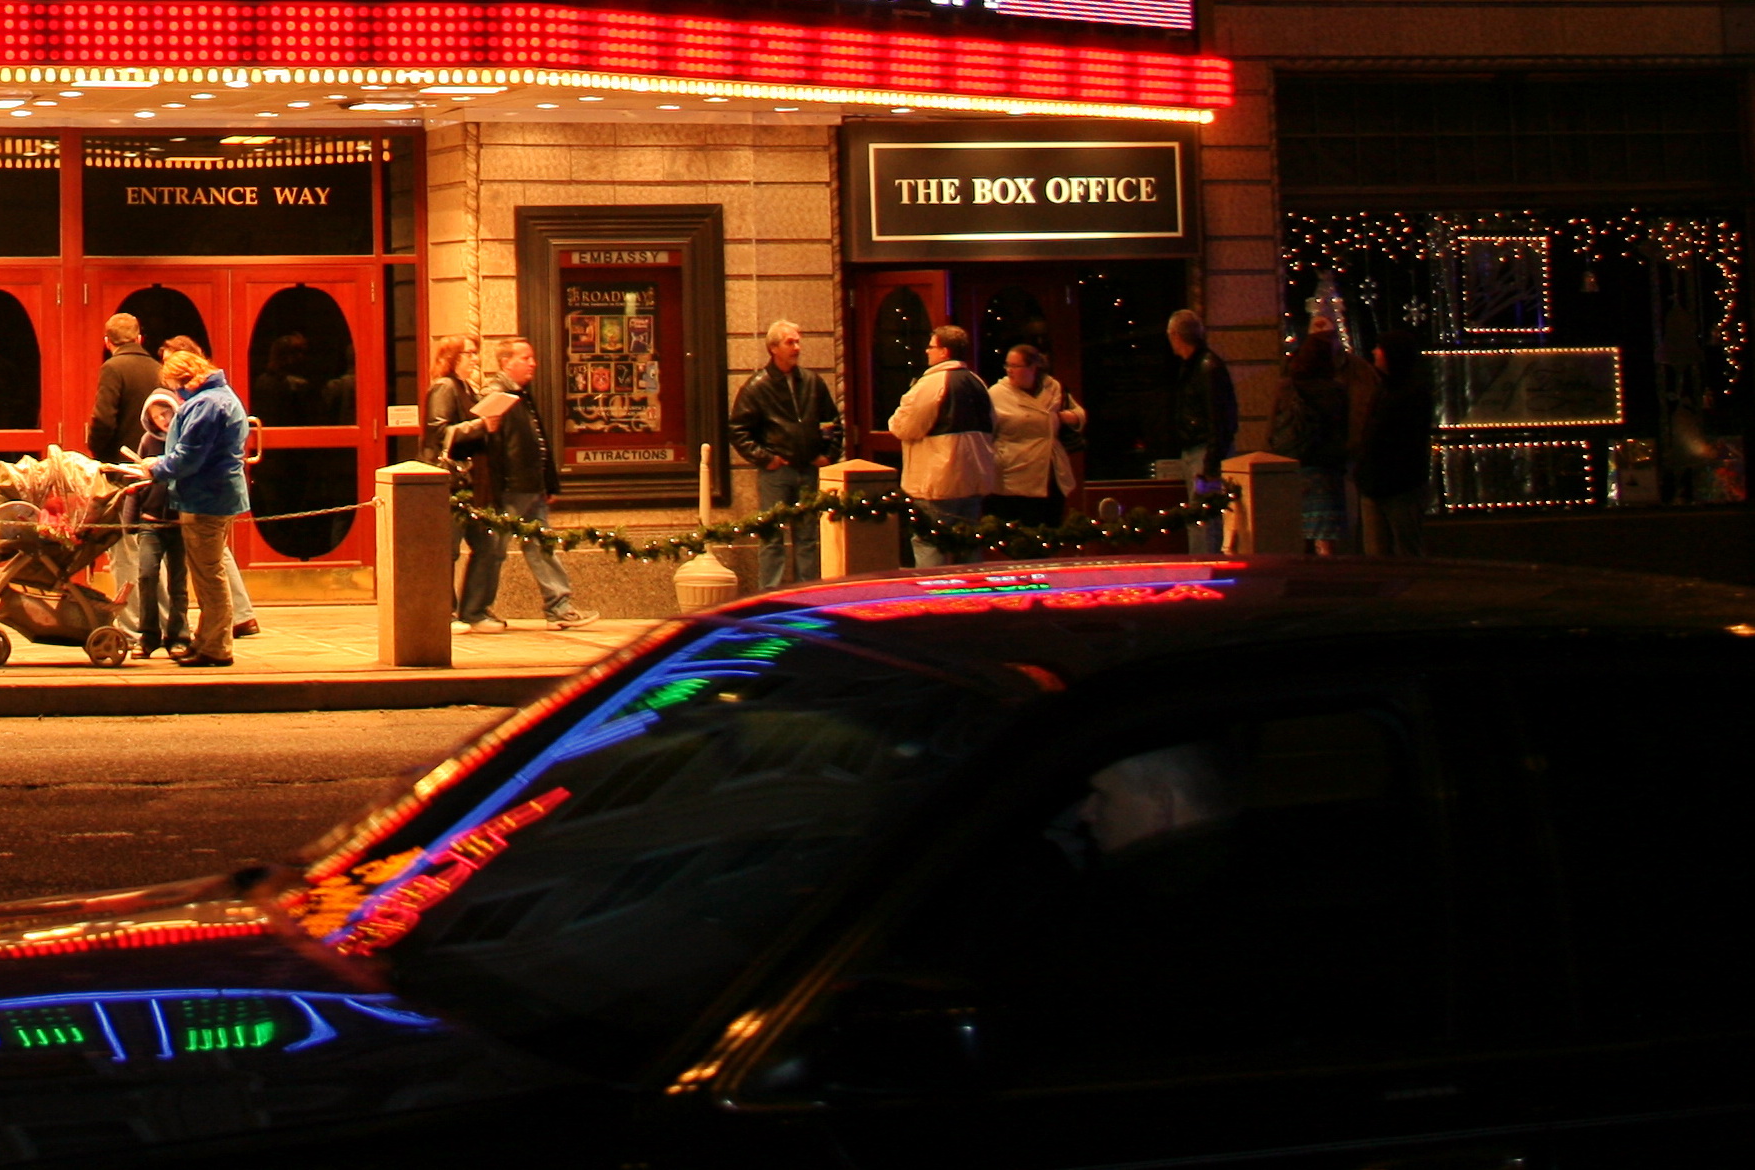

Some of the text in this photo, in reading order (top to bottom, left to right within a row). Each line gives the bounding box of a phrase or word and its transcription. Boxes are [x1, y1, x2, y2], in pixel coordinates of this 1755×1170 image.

[126, 186, 331, 206] ENTRANCE WAY
[895, 176, 1157, 205] THE BOX OFFICE
[579, 250, 661, 264] EMBASSY
[582, 449, 668, 462] ATTRACTIONS
